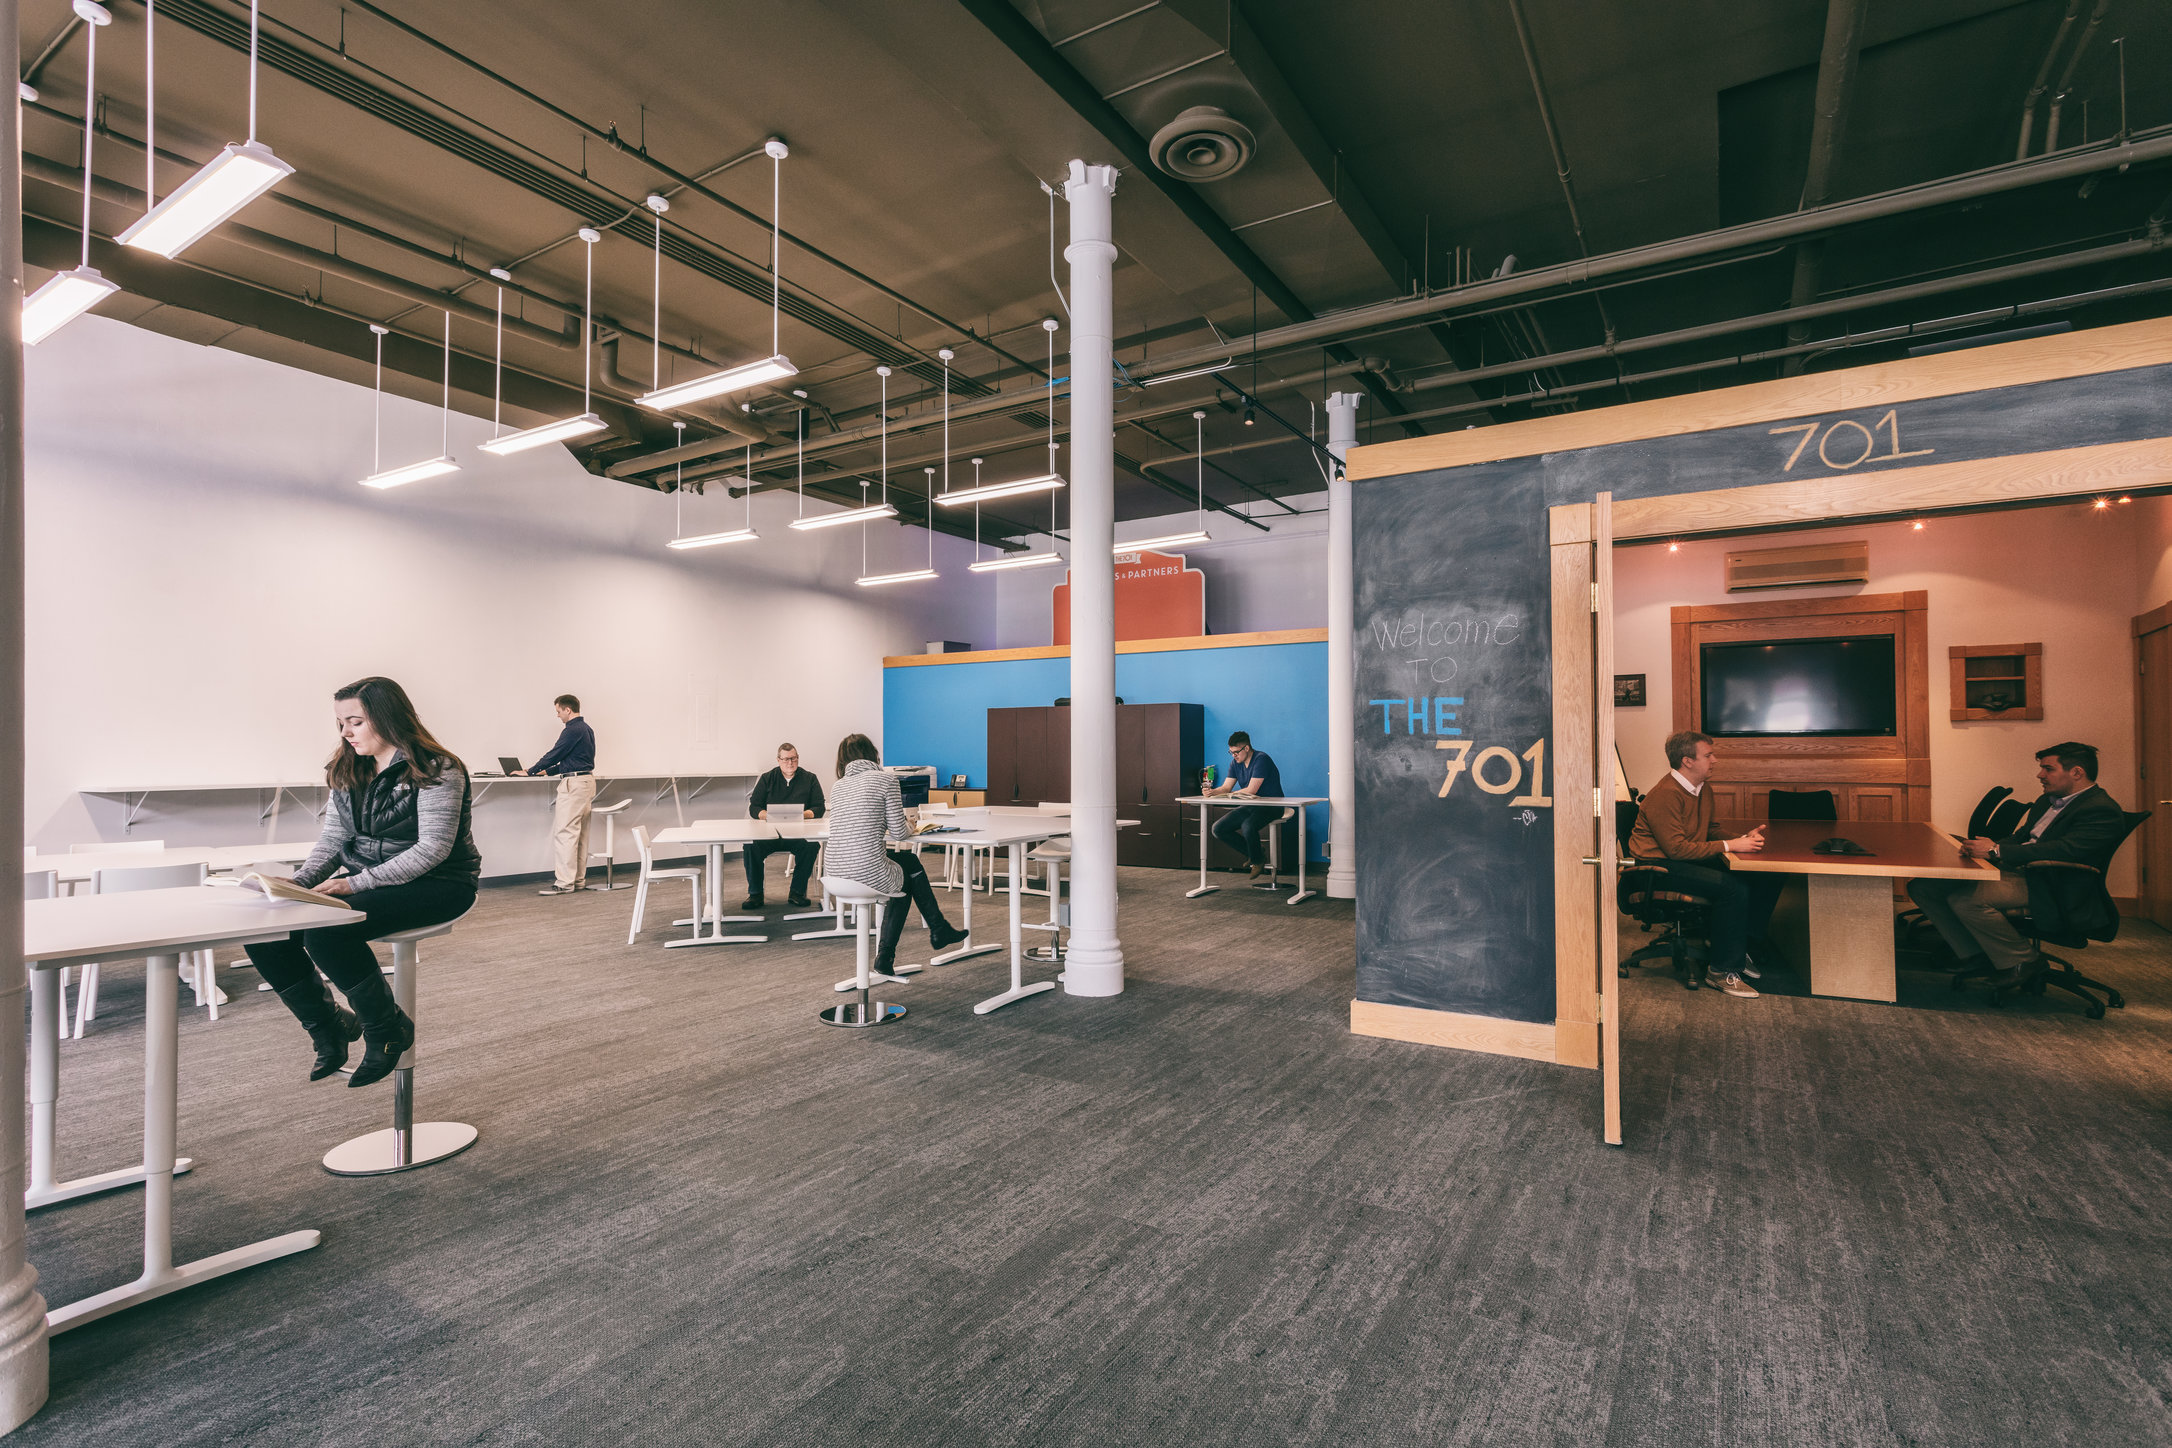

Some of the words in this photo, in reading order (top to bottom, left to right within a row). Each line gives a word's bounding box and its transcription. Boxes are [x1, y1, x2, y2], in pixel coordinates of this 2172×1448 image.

[1768, 409, 1935, 472] 701
[1128, 566, 1179, 579] PARTNERS
[1371, 613, 1521, 651] Welcome
[1406, 656, 1458, 684] TO
[1369, 697, 1465, 735] THE
[1435, 738, 1553, 808] 701
